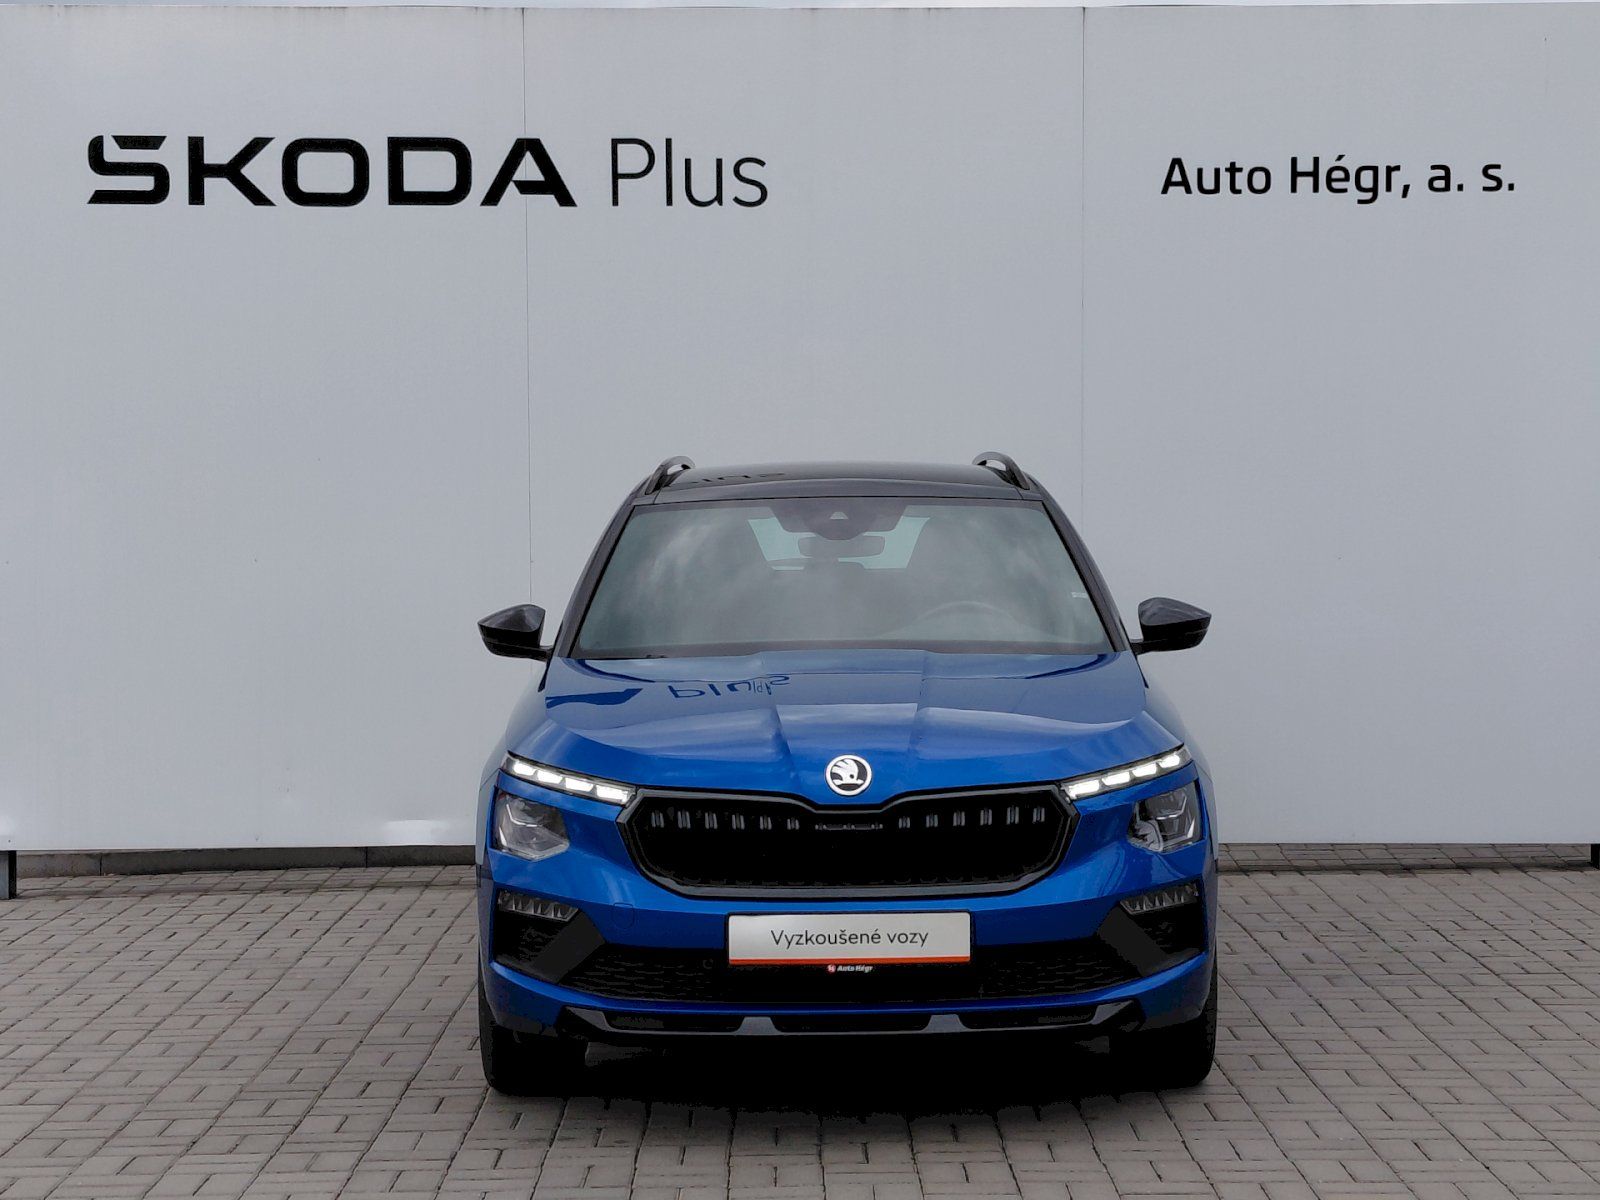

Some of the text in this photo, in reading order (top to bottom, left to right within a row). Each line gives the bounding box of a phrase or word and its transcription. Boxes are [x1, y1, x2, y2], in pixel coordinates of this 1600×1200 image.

[611, 138, 767, 207] Plus
[1161, 155, 1515, 204] Auto Hégr, a. s.
[770, 928, 929, 949] Vyzkoušené vozy
